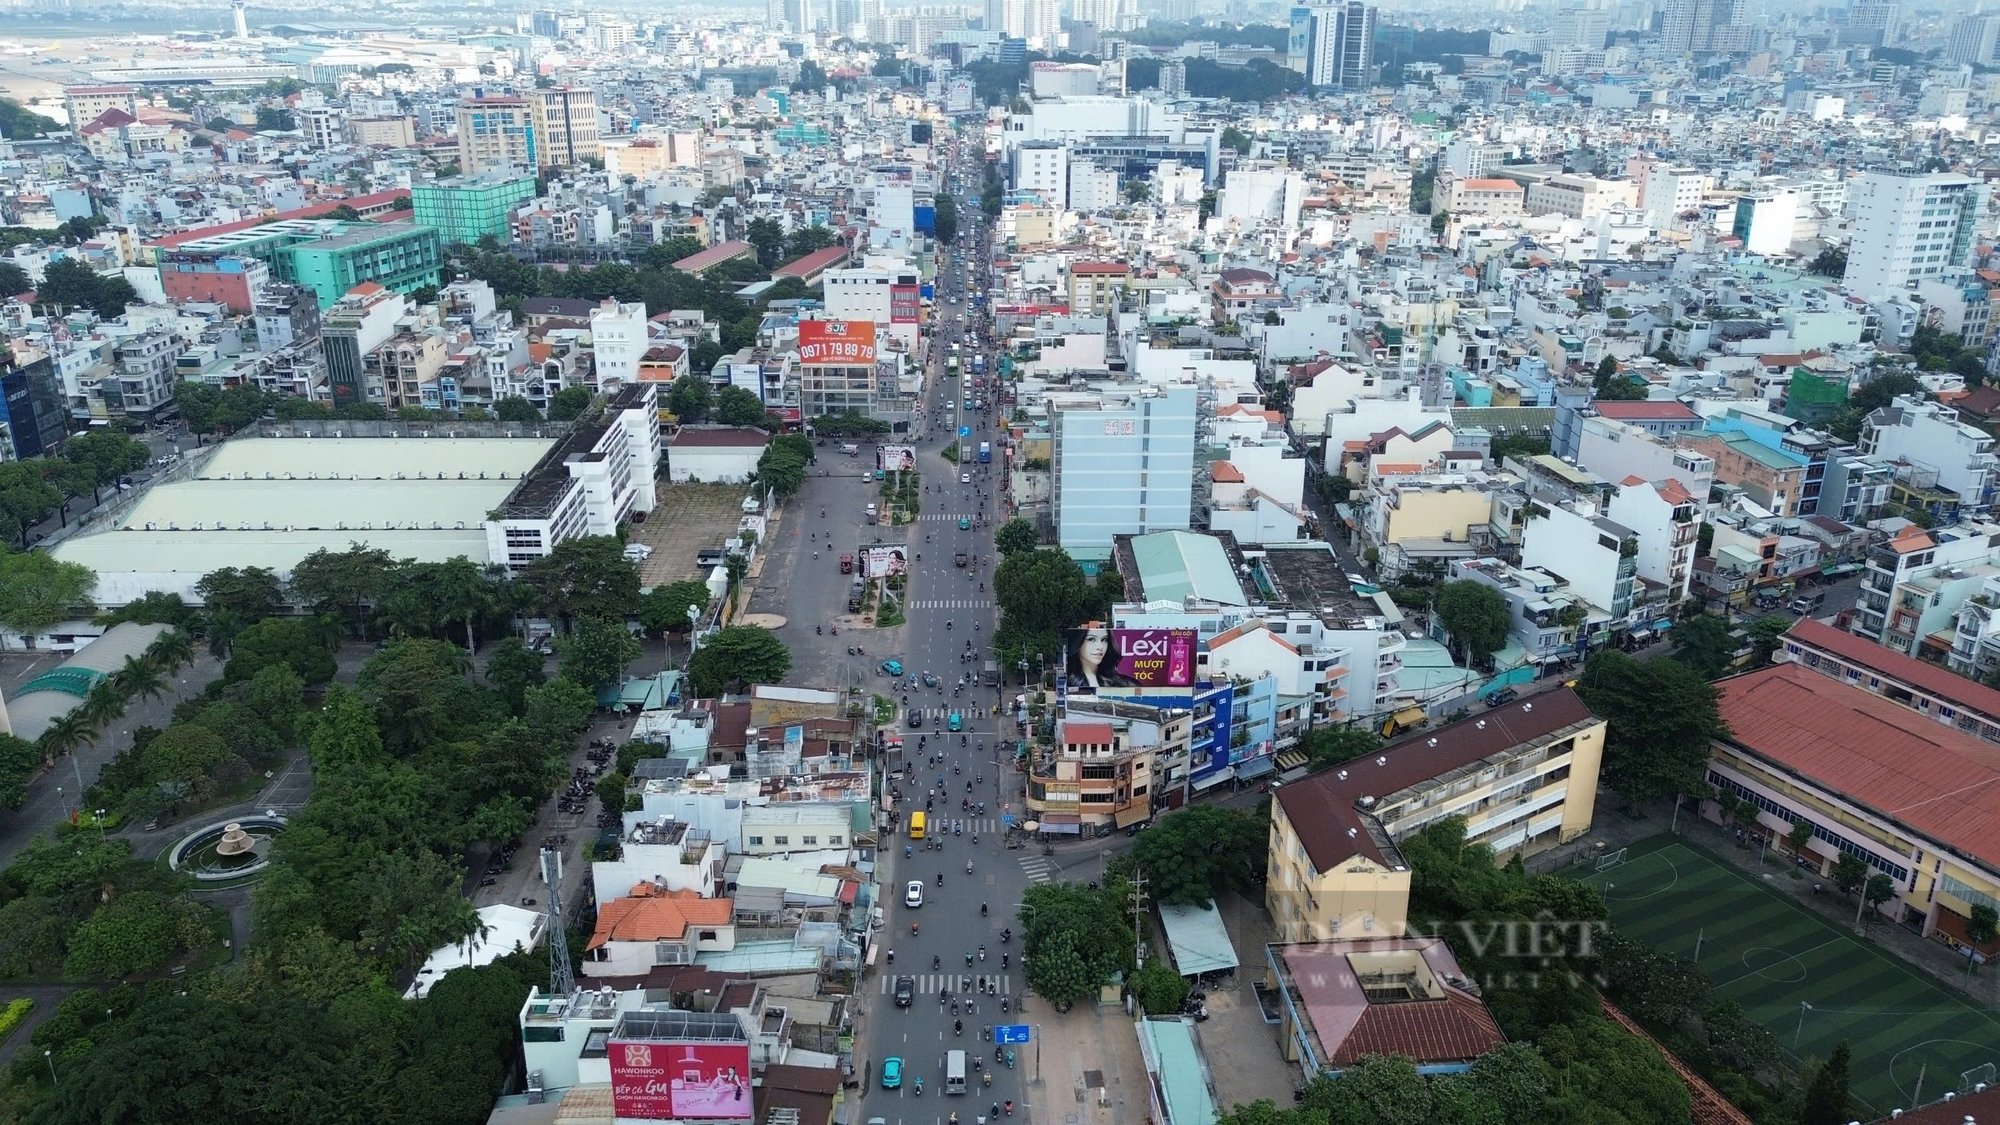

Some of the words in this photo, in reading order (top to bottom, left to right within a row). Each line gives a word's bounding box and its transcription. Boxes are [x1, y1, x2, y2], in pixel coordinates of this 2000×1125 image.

[826, 324, 846, 333] SJK
[801, 343, 827, 358] 0971
[829, 342, 843, 355] 79
[845, 343, 858, 356] 89
[860, 345, 874, 359] 79
[1121, 631, 1168, 657] Léxi
[1134, 660, 1165, 671] MƯỢT
[1134, 671, 1154, 680] TÓC
[614, 1067, 665, 1075] HAWONKOO
